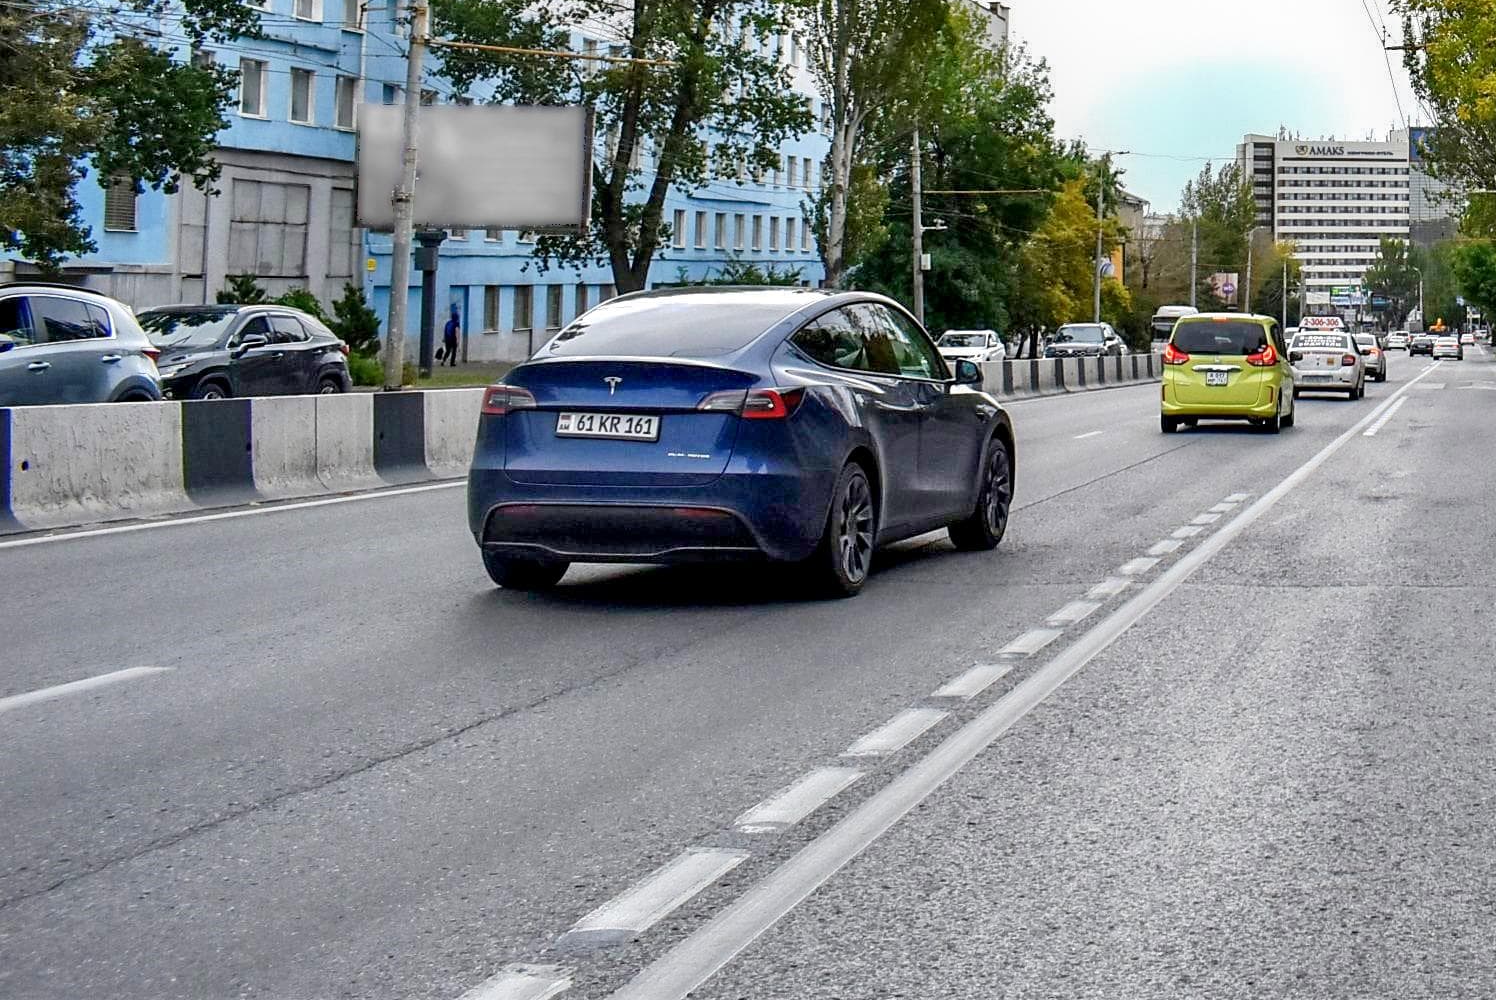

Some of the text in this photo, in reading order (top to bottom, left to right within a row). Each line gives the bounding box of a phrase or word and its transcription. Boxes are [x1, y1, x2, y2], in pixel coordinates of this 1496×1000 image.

[1309, 146, 1345, 156] AMAKS
[1304, 318, 1340, 326] 2-306-306
[576, 415, 652, 435] 61 KR 161
